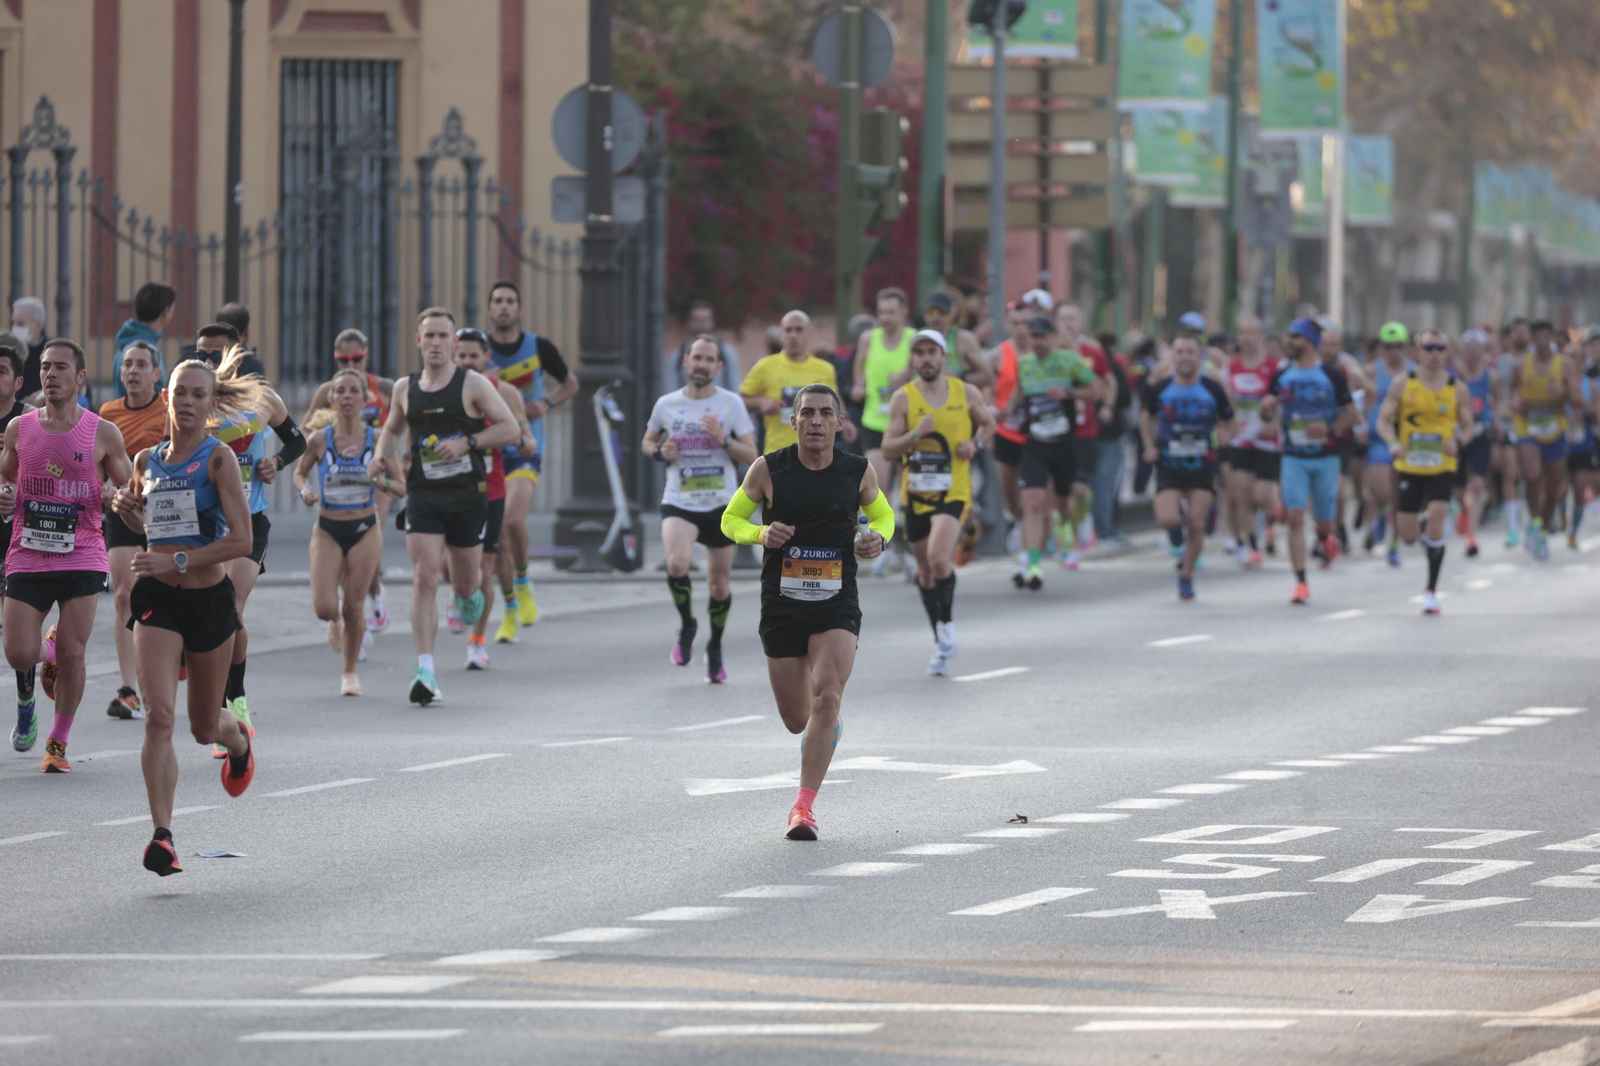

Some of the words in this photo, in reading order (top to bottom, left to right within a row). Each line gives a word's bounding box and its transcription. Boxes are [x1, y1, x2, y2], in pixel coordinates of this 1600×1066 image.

[340, 465, 365, 473] ZURICH
[693, 467, 719, 475] ZURICH
[58, 479, 90, 499] FLATO
[156, 479, 187, 490] ZURICH
[155, 499, 174, 509] F229
[39, 504, 71, 515] ZURICH
[152, 513, 181, 524] ADRIANA
[38, 519, 57, 529] 1801
[31, 530, 50, 540] RUBEN
[51, 532, 65, 541] GSA
[802, 550, 836, 558] ZURICH
[802, 567, 822, 576] 3893
